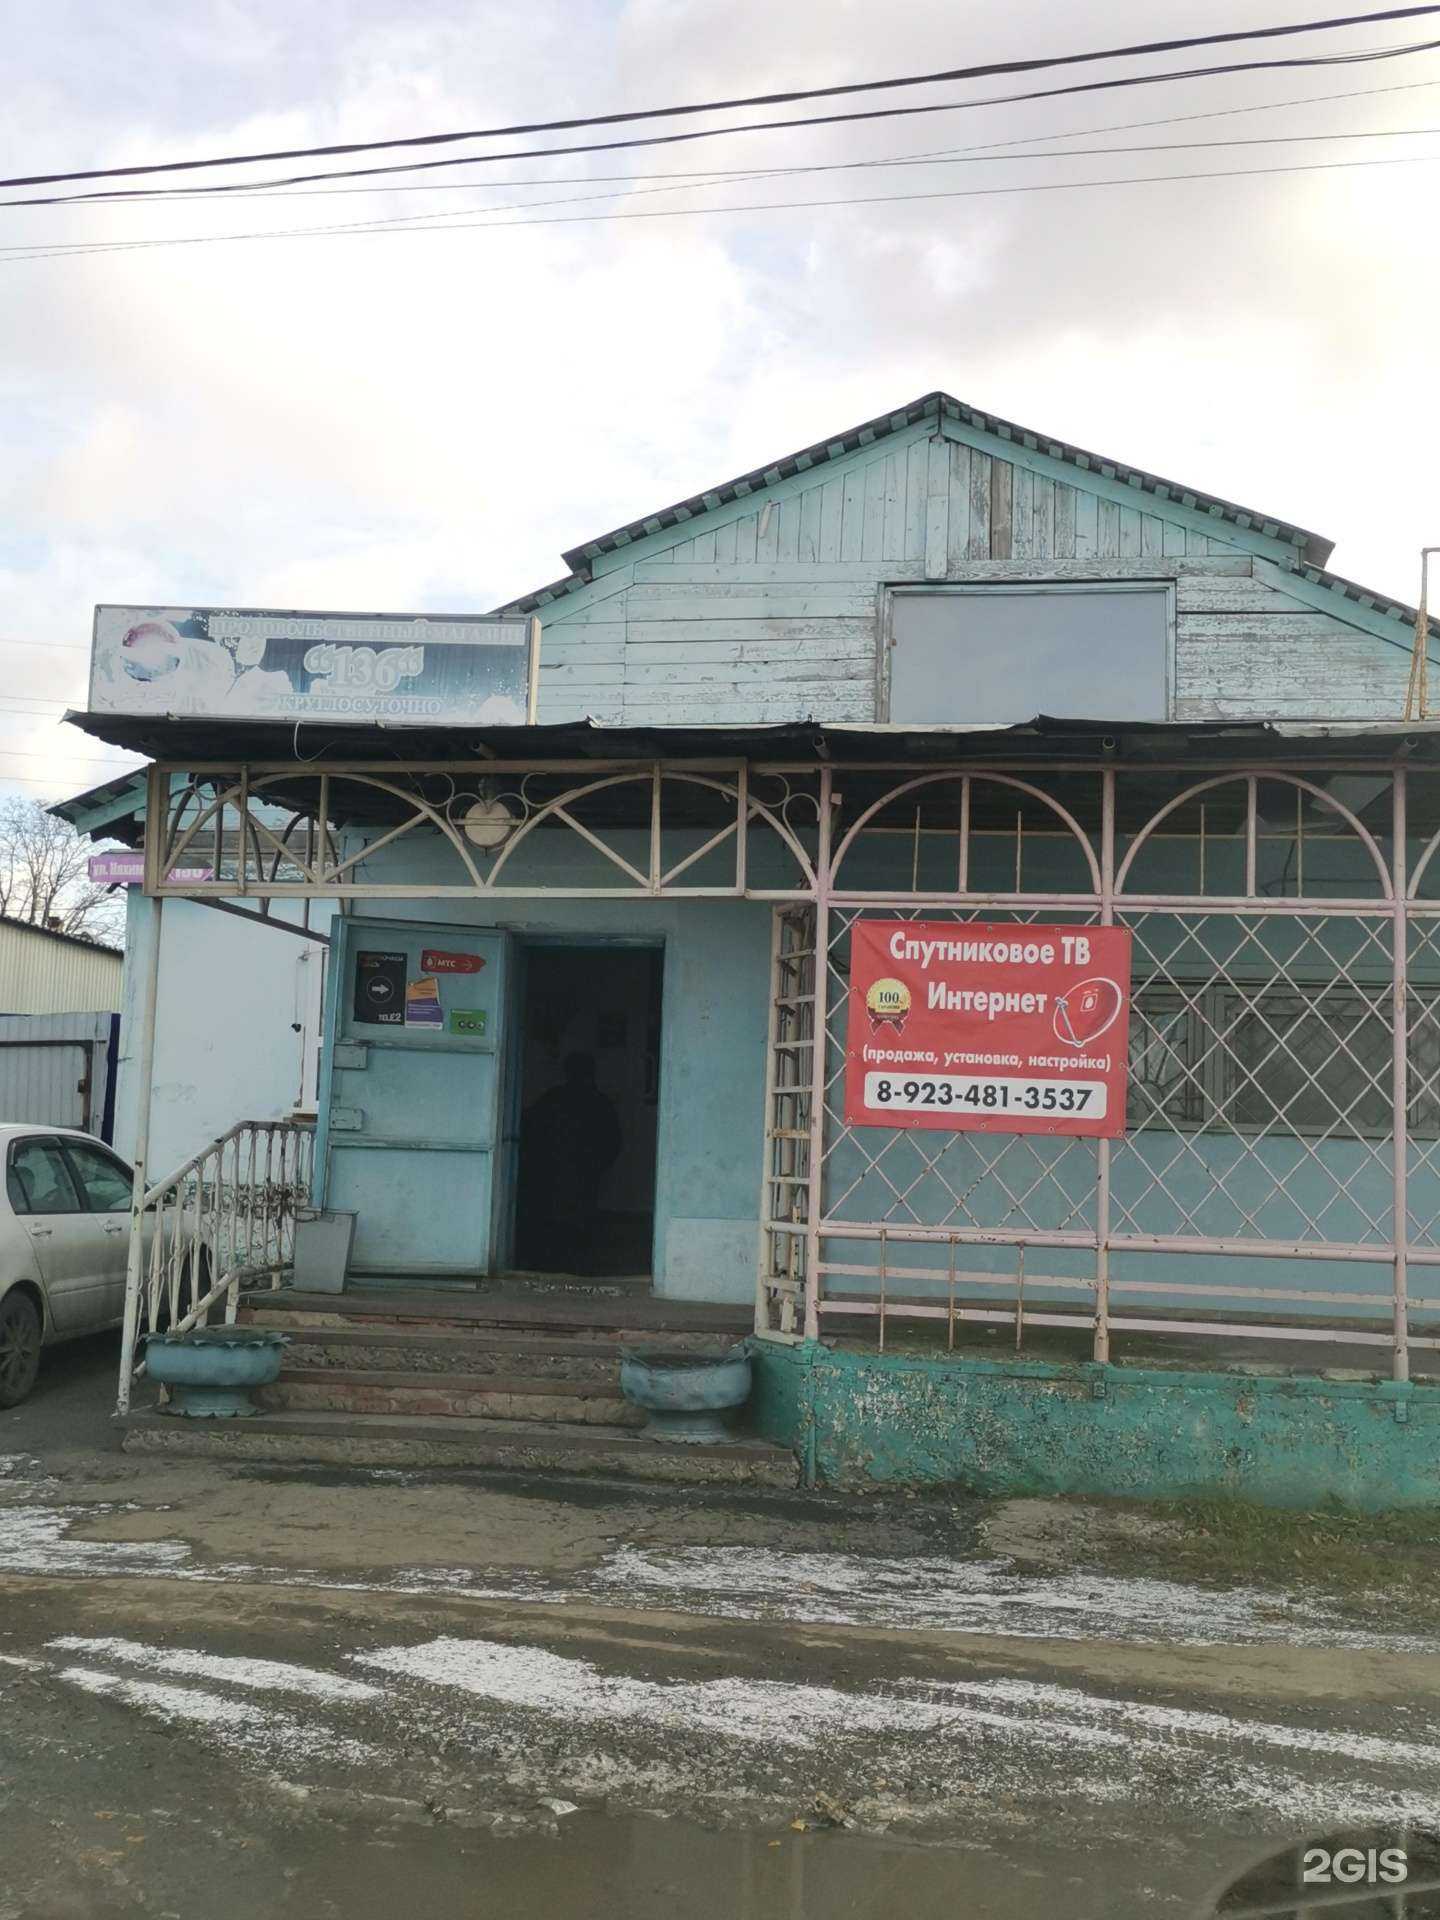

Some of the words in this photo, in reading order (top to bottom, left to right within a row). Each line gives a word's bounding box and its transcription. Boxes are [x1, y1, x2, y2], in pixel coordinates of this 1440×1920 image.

[889, 931, 1055, 968] Спутниковое
[1061, 936, 1091, 965] ТВ
[927, 981, 1047, 1020] Интернет
[863, 1044, 938, 1065] (продажа,
[944, 1052, 1023, 1068] установка,
[1028, 1053, 1111, 1072] настройка)
[876, 1080, 1093, 1112] 8-923-481-3537
